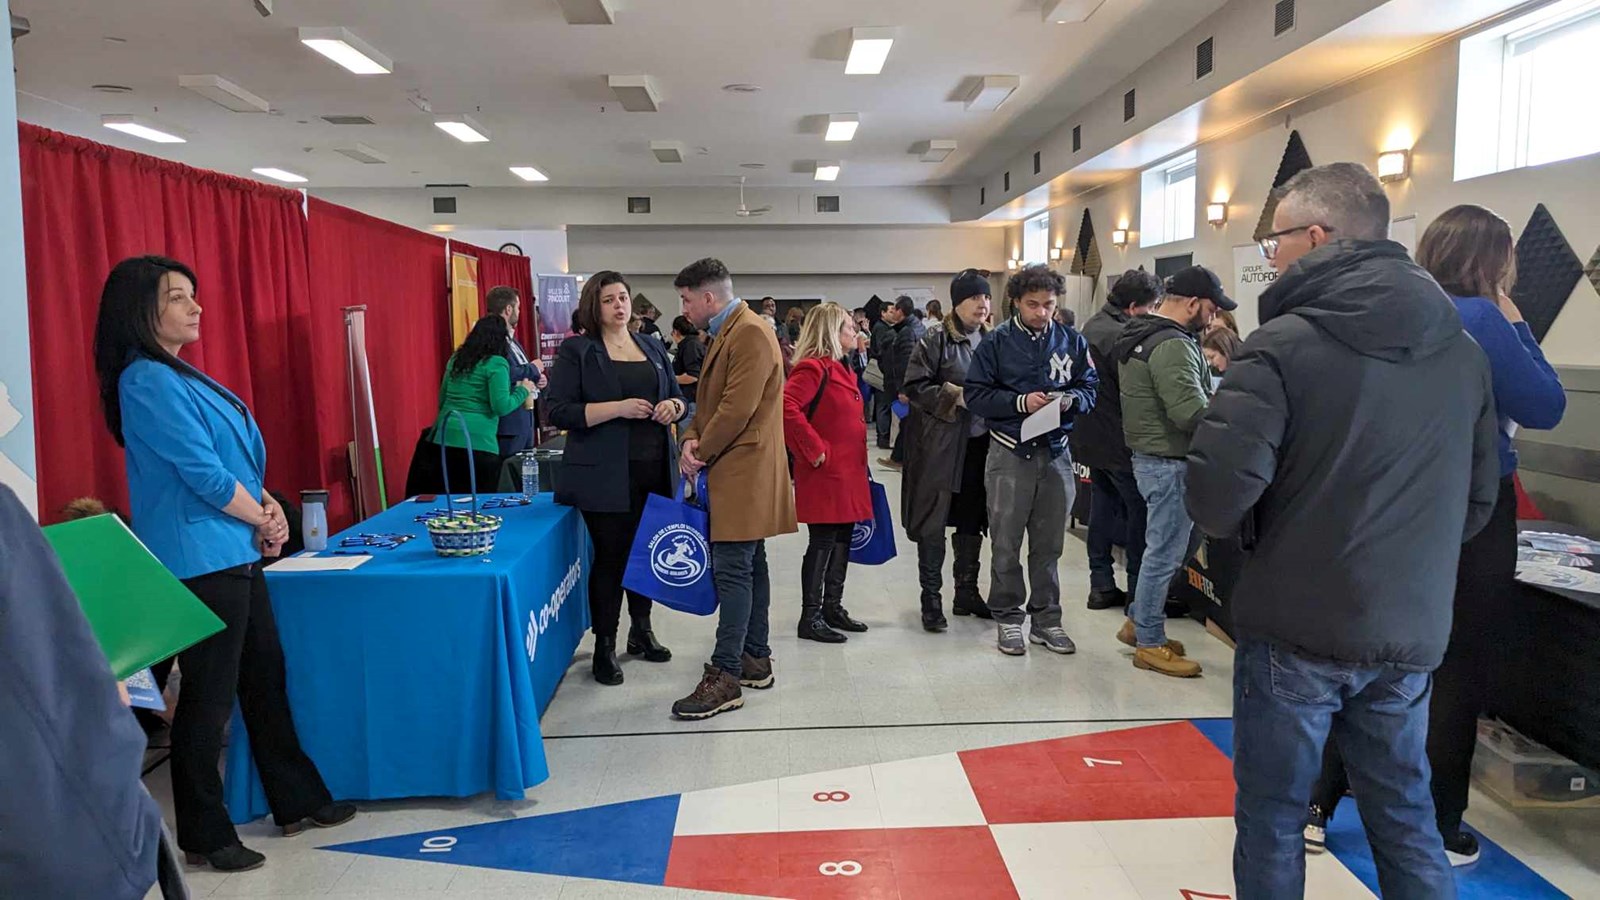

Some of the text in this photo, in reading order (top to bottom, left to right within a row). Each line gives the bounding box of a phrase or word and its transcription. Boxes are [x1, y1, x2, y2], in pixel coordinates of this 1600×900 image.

[1242, 265, 1264, 273] GROUPE
[1049, 352, 1073, 384] NY
[648, 532, 660, 550] SALON
[665, 523, 686, 533] L'EMPLOI
[539, 557, 581, 635] co-operators
[1082, 757, 1123, 768] 7
[813, 791, 850, 803] 8
[419, 836, 458, 853] 10
[819, 860, 863, 877] 8
